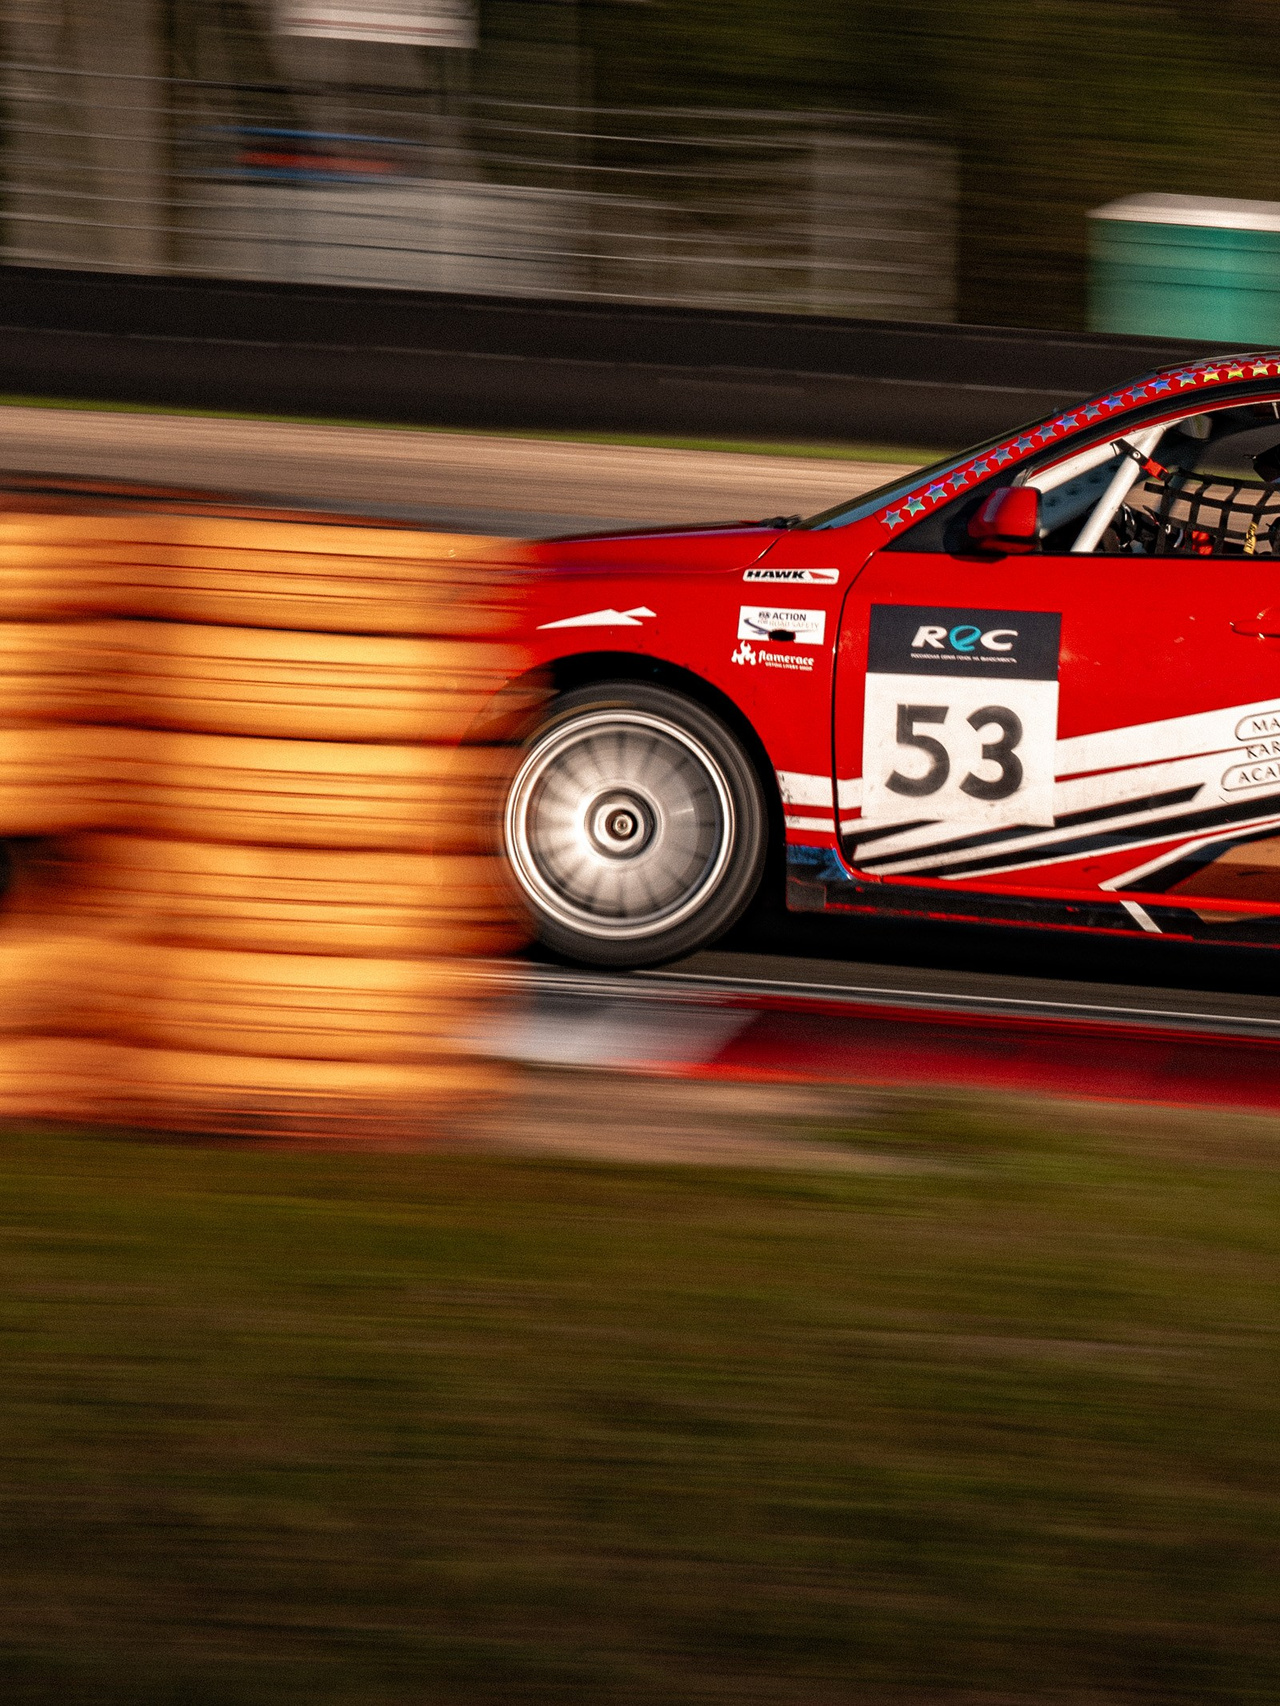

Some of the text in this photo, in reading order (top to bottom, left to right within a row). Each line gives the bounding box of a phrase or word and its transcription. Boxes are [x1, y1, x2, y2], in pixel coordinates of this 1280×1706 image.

[746, 570, 806, 580] HAWK
[772, 611, 807, 621] ACTION
[758, 650, 815, 666] flamerace
[885, 703, 1023, 801] 53
